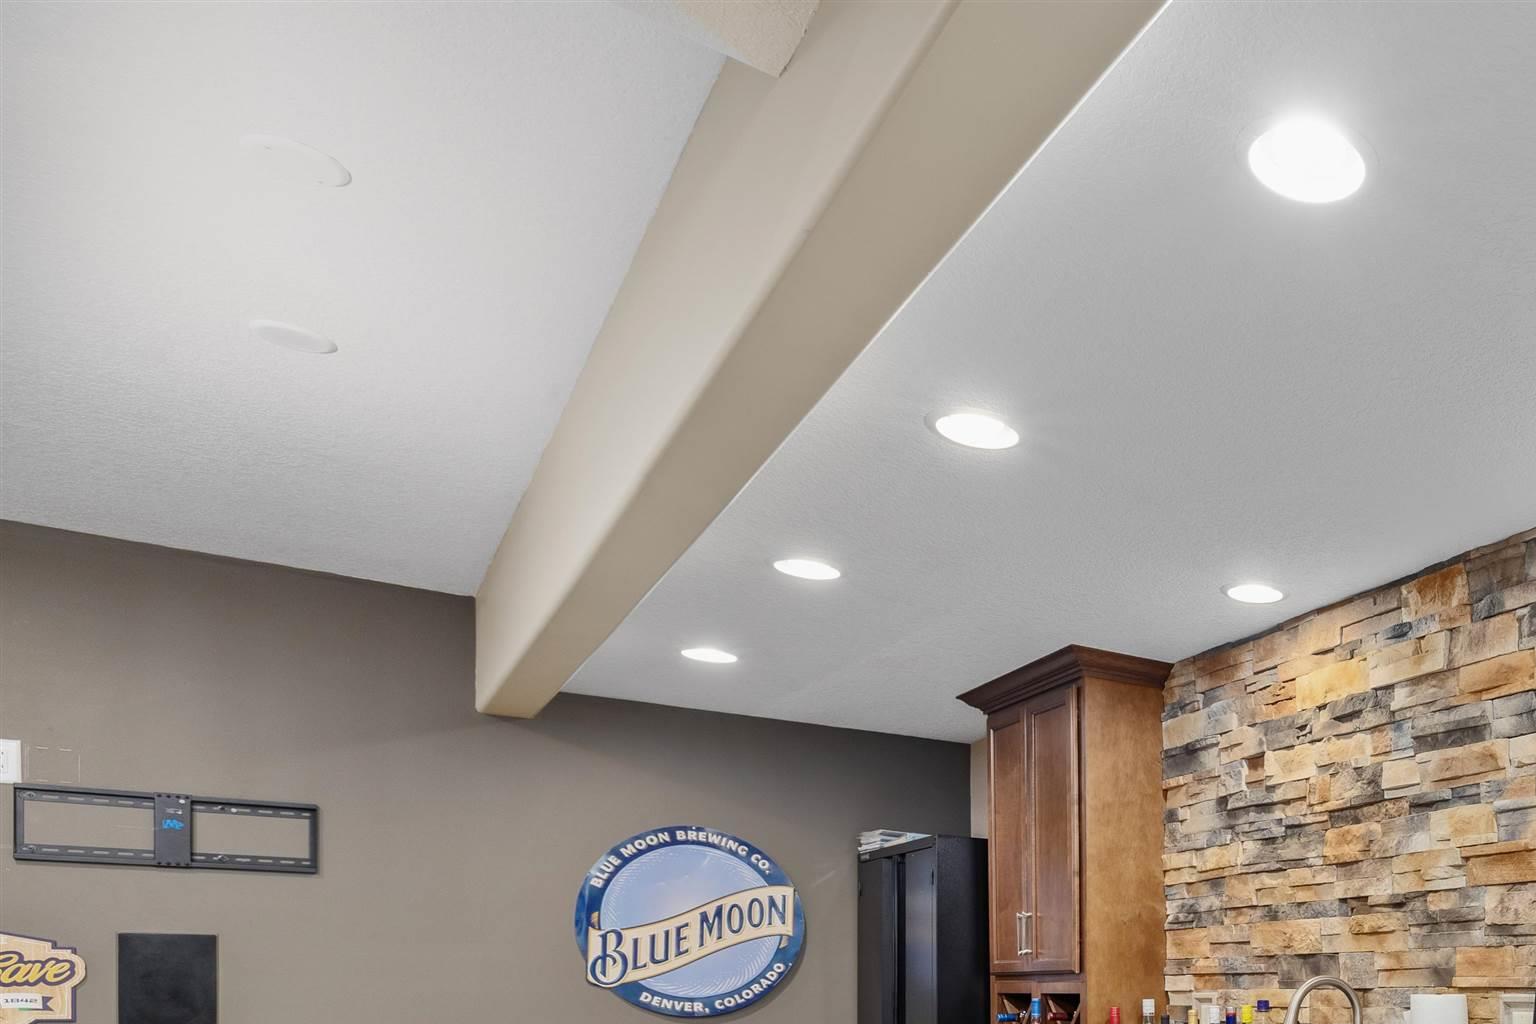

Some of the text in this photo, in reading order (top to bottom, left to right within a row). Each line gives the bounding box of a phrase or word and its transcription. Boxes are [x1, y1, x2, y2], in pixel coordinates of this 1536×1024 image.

[590, 853, 622, 889] BLUE
[620, 831, 670, 858] MOON
[675, 829, 749, 858] BREWING
[589, 894, 788, 988] BLUE MOON
[639, 962, 787, 1014] DENVER, COLORADO
